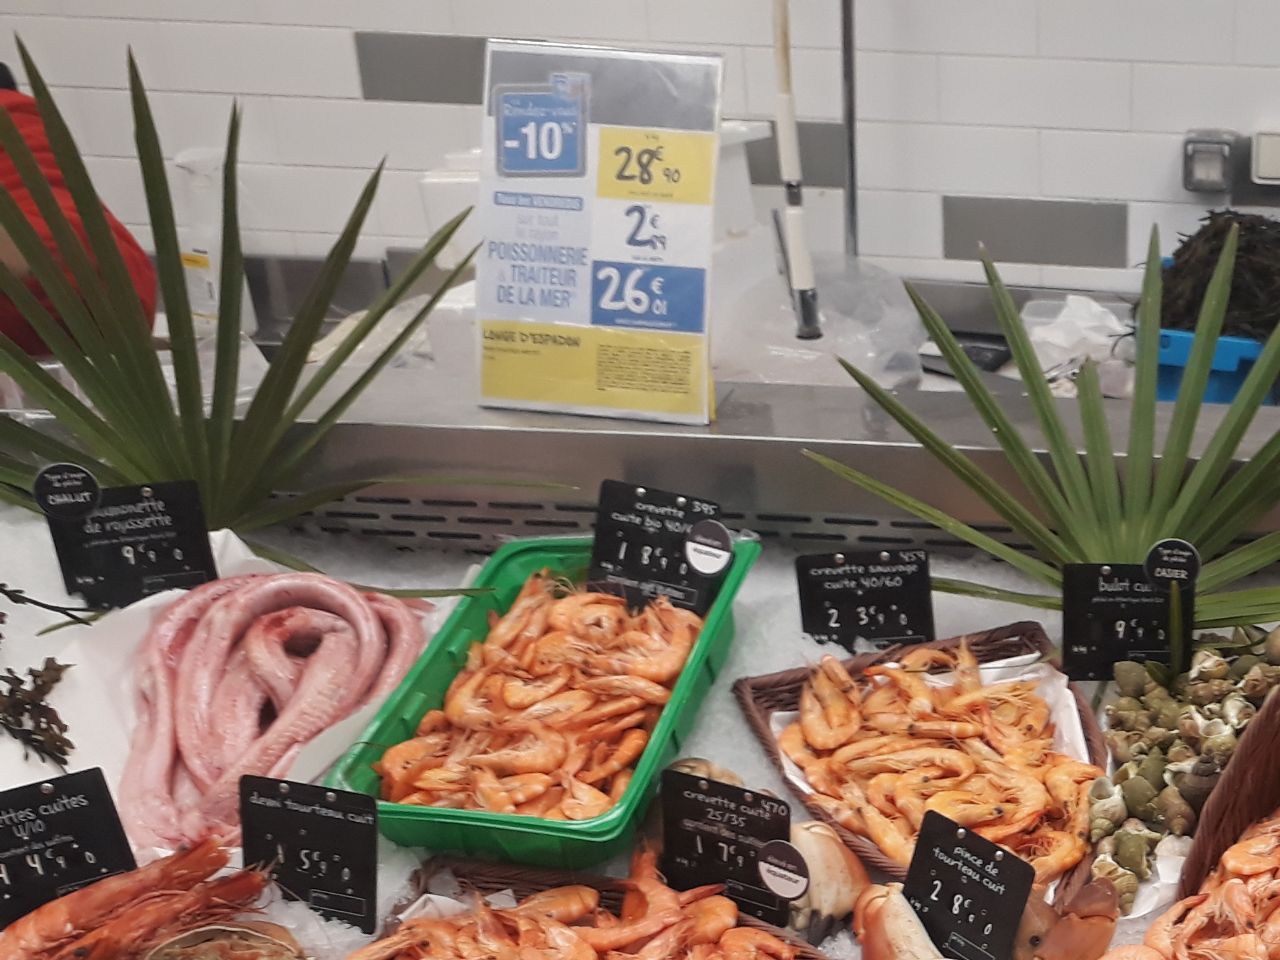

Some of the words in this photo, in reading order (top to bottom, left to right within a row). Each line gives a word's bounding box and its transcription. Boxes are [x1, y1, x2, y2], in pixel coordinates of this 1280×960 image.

[614, 145, 654, 185] 28
[488, 241, 589, 266] POISSONNERIE
[511, 265, 577, 288] TRAITEUR
[496, 284, 515, 304] DE
[518, 287, 536, 305] LA
[596, 266, 651, 314] 26
[38, 794, 89, 815] cuites
[683, 790, 736, 811] crevette
[932, 847, 981, 882] tourteau
[983, 878, 1006, 895] cuit
[953, 847, 983, 868] pince
[985, 861, 999, 877] de
